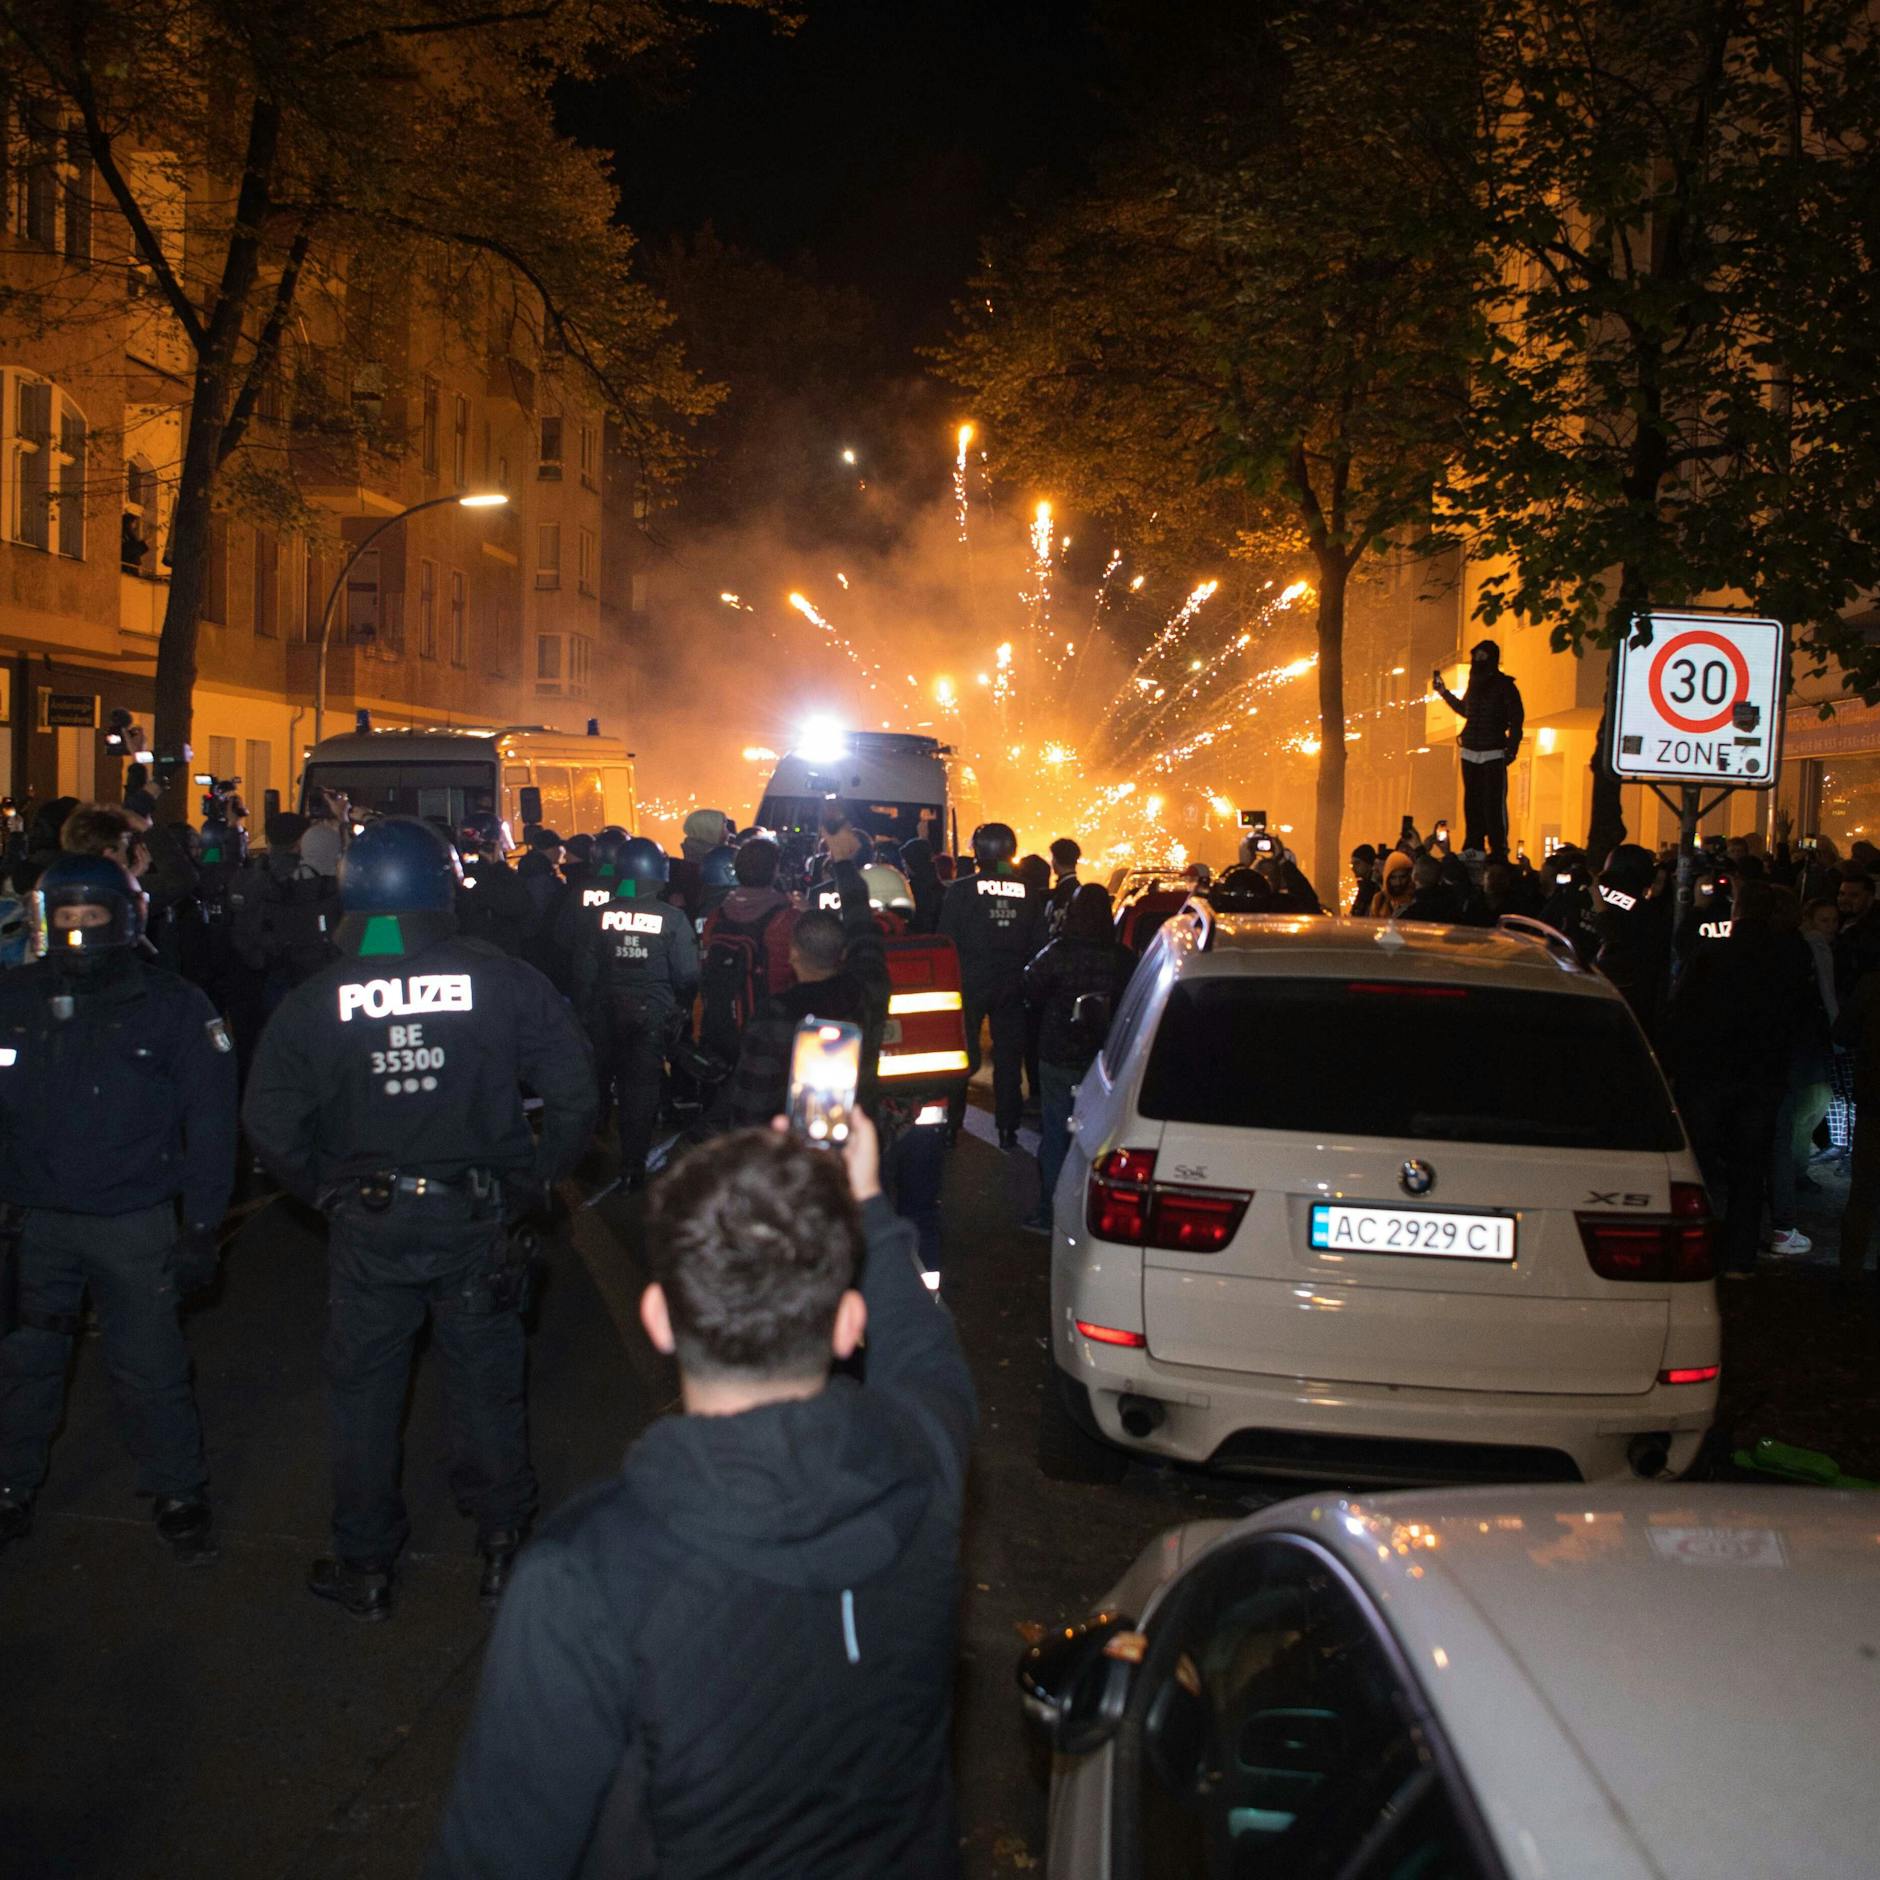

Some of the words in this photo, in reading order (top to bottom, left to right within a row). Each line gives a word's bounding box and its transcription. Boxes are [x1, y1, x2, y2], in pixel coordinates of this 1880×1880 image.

[1670, 659, 1728, 706] 30
[977, 880, 1027, 899] POLIZEI
[601, 911, 663, 935] POLIZEI
[615, 946, 649, 959] 35304
[623, 935, 640, 947] BE
[338, 974, 473, 1022] POLIZEI
[388, 1023, 425, 1049] BE
[370, 1047, 446, 1075] 35300
[1583, 1191, 1652, 1208] X5
[1335, 1216, 1377, 1244] AC
[1386, 1219, 1457, 1250] 2929
